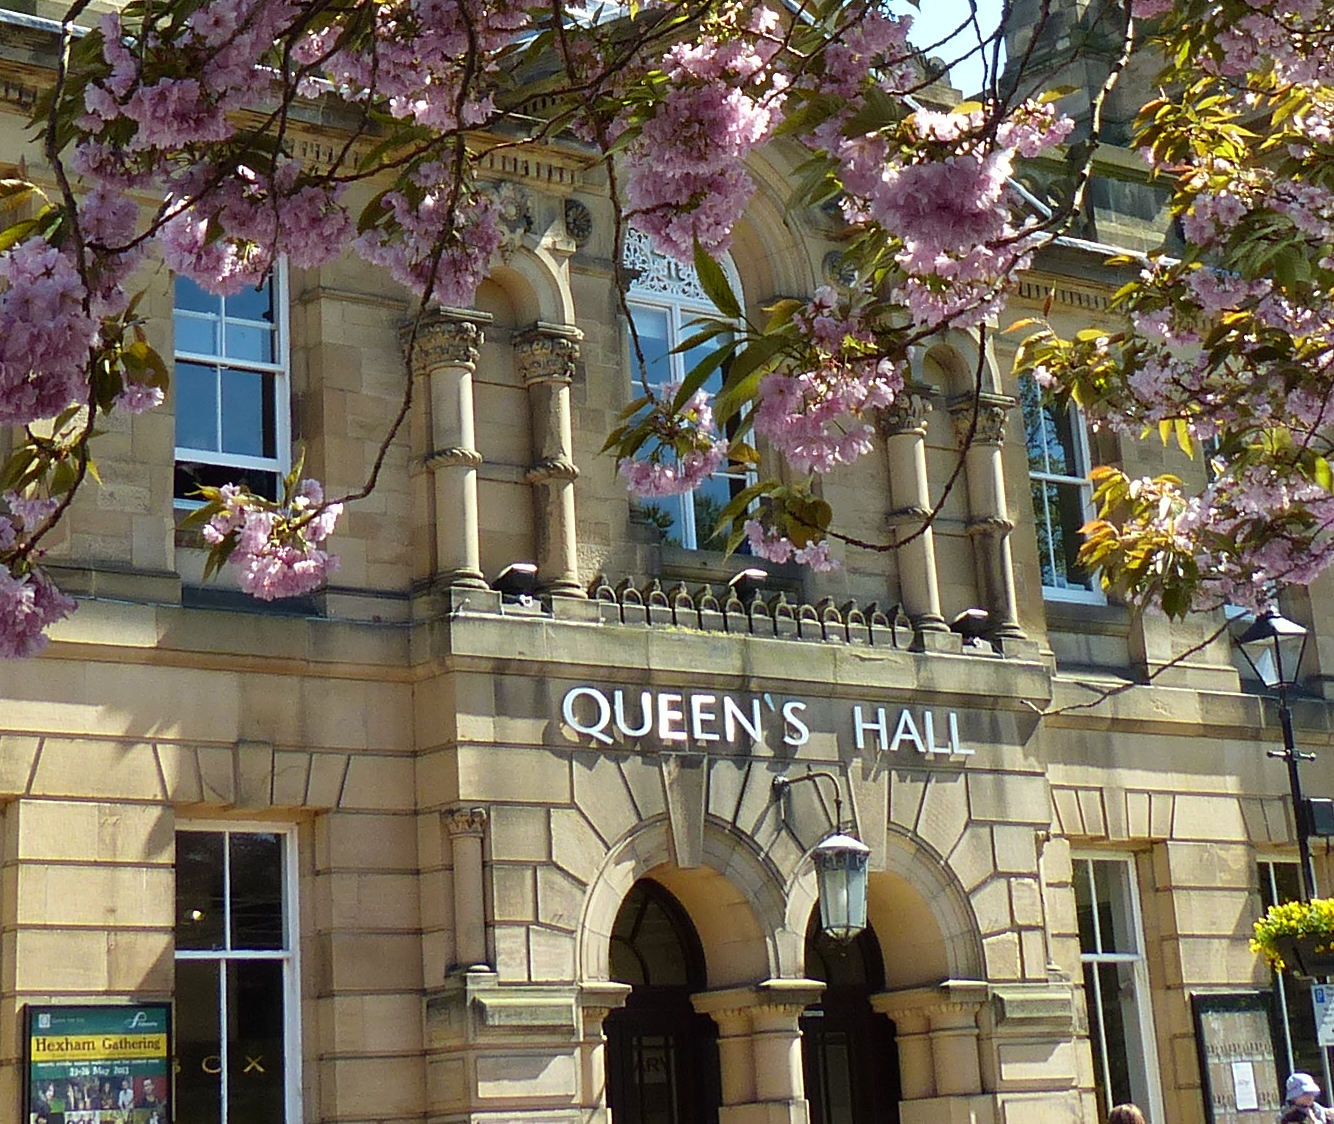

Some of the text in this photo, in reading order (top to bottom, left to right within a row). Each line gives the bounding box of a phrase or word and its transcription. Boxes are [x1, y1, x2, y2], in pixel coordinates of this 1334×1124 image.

[562, 687, 975, 755] QUEEN'S HALL
[35, 1036, 161, 1052] Hexham Gathering
[92, 1066, 110, 1076] May
